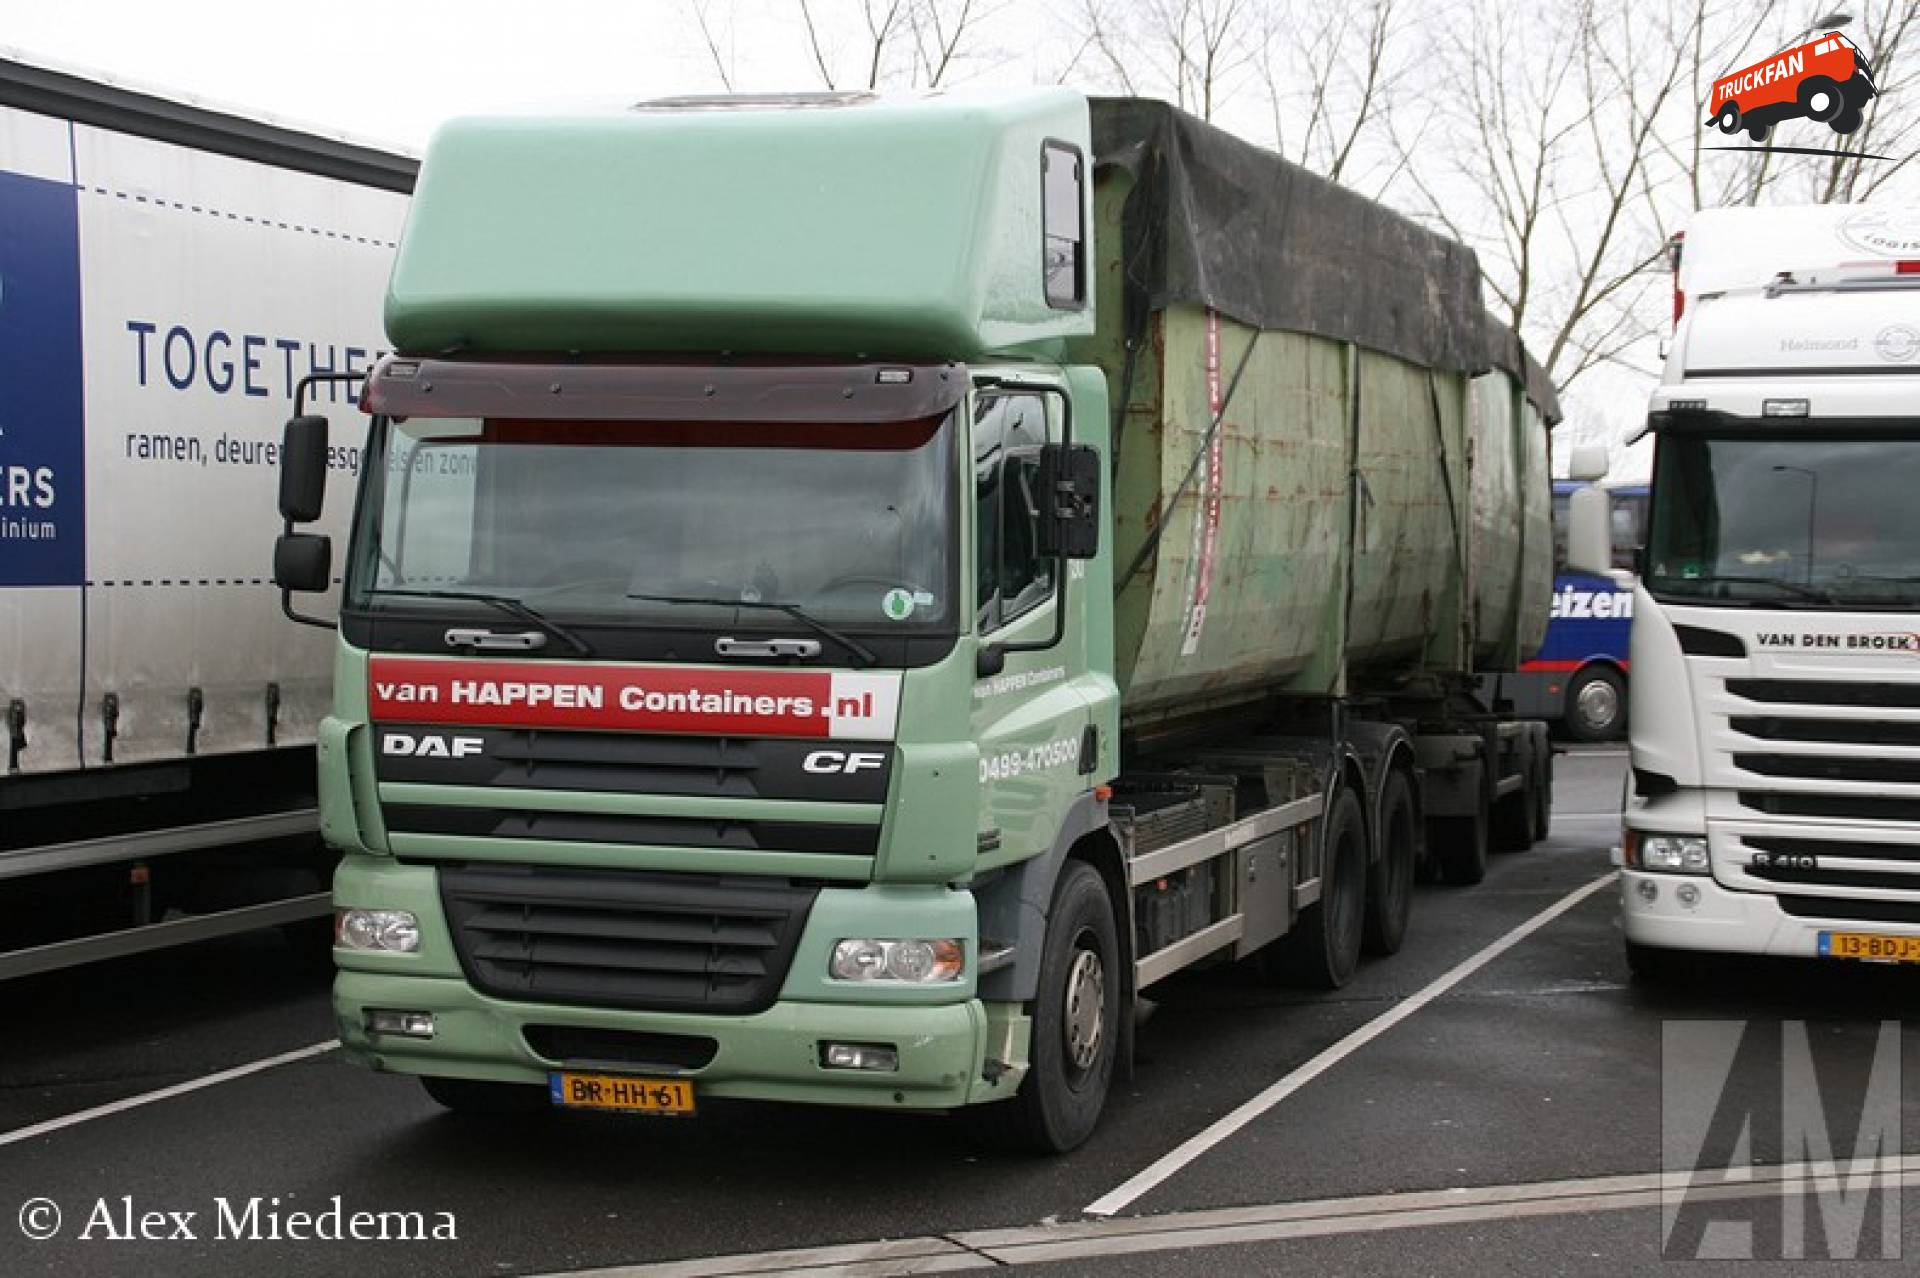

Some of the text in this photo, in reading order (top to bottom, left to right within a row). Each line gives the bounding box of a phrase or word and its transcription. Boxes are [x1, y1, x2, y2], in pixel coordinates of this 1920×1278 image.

[126, 320, 397, 404] TOGETHE
[126, 433, 207, 467] ramen,
[215, 431, 286, 465] deure
[0, 465, 55, 508] RS
[1756, 632, 1910, 650] VAN DEN BROEK
[376, 681, 439, 702] van
[451, 680, 604, 708] HAPPEN
[382, 733, 485, 758] DAF
[802, 751, 886, 774] CF
[1840, 937, 1920, 957] 13-BDJ-
[572, 1079, 684, 1106] BR-HH-61
